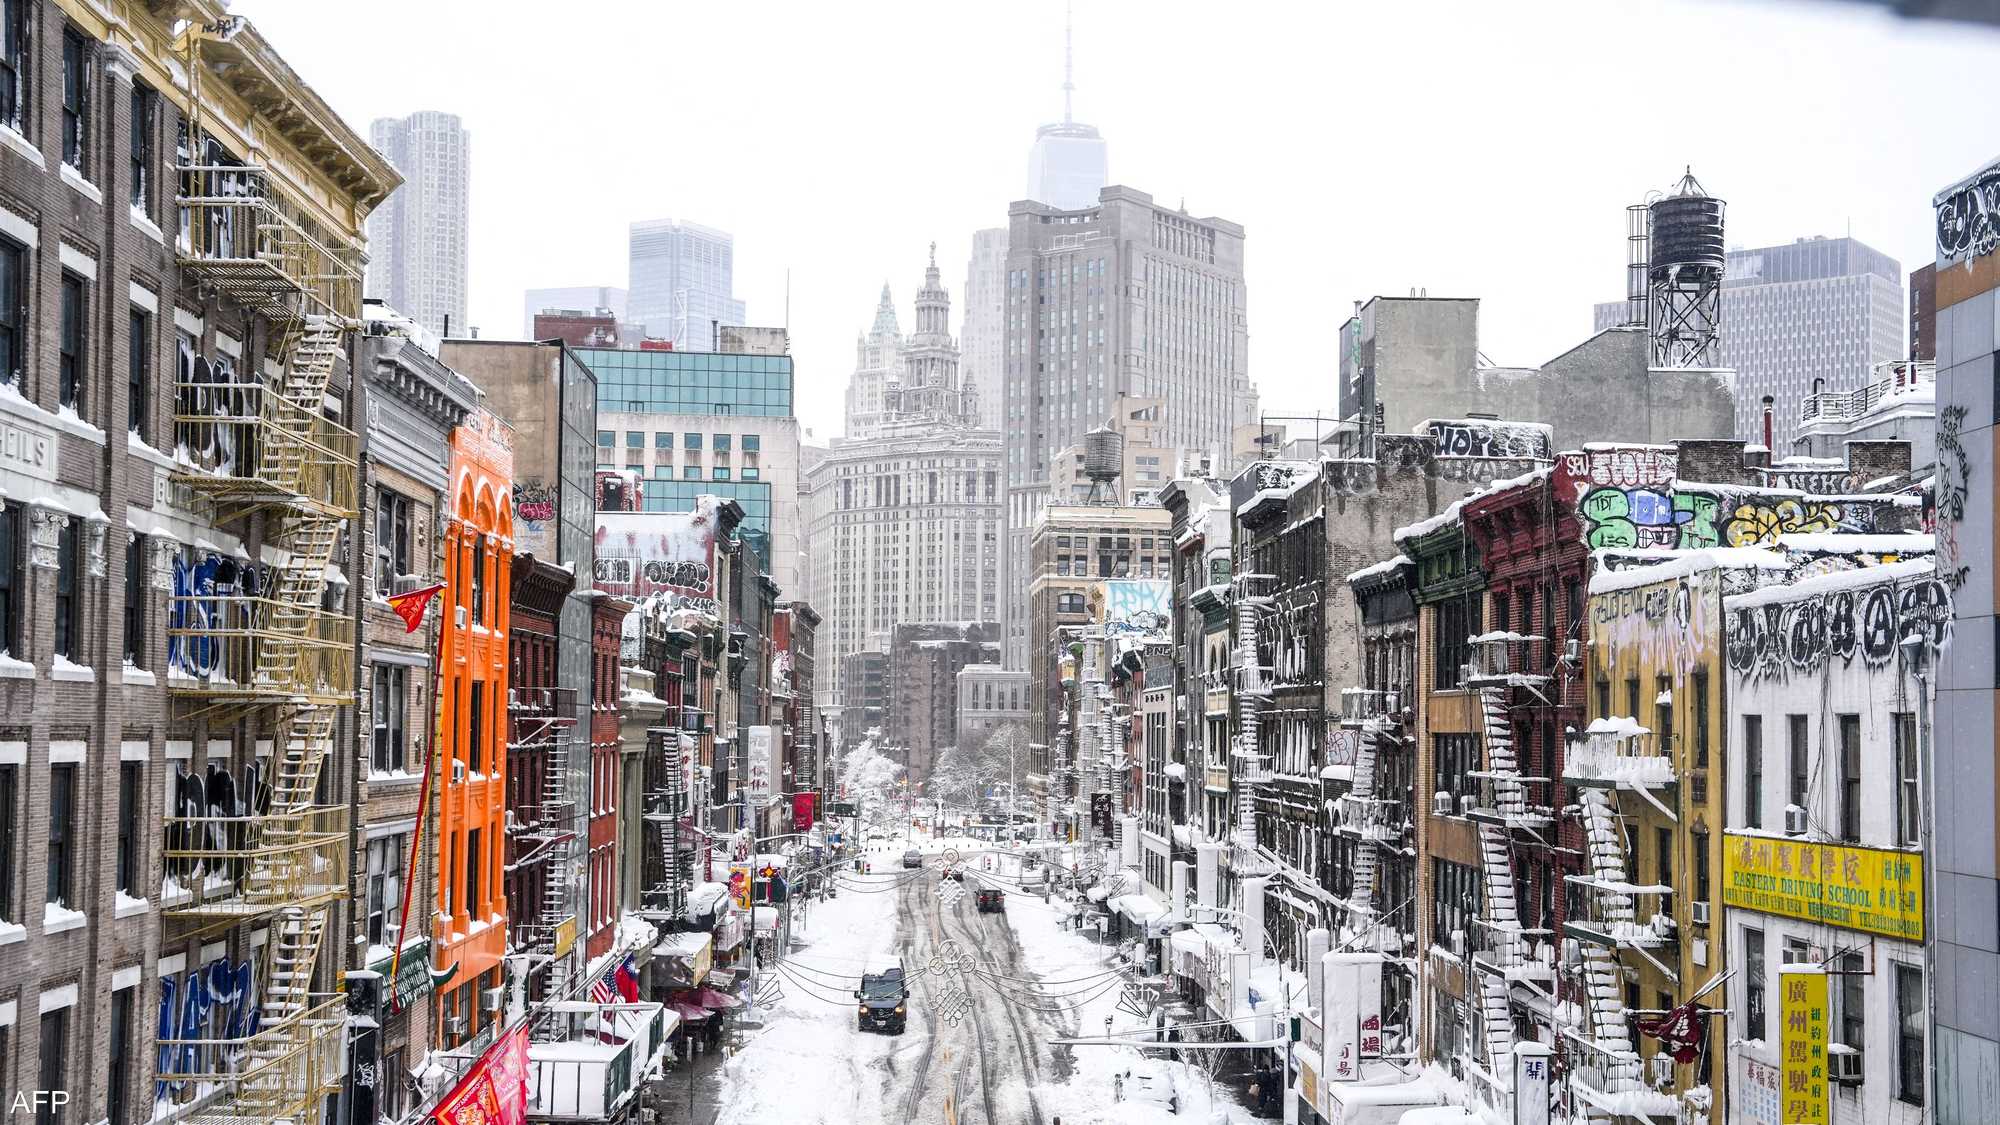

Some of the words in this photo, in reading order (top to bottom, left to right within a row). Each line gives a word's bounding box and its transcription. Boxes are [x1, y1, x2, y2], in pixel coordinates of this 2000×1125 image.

[1733, 871, 1776, 892] EASTERN
[1781, 877, 1823, 900] DRIVING
[1828, 884, 1872, 908] SCHOOL
